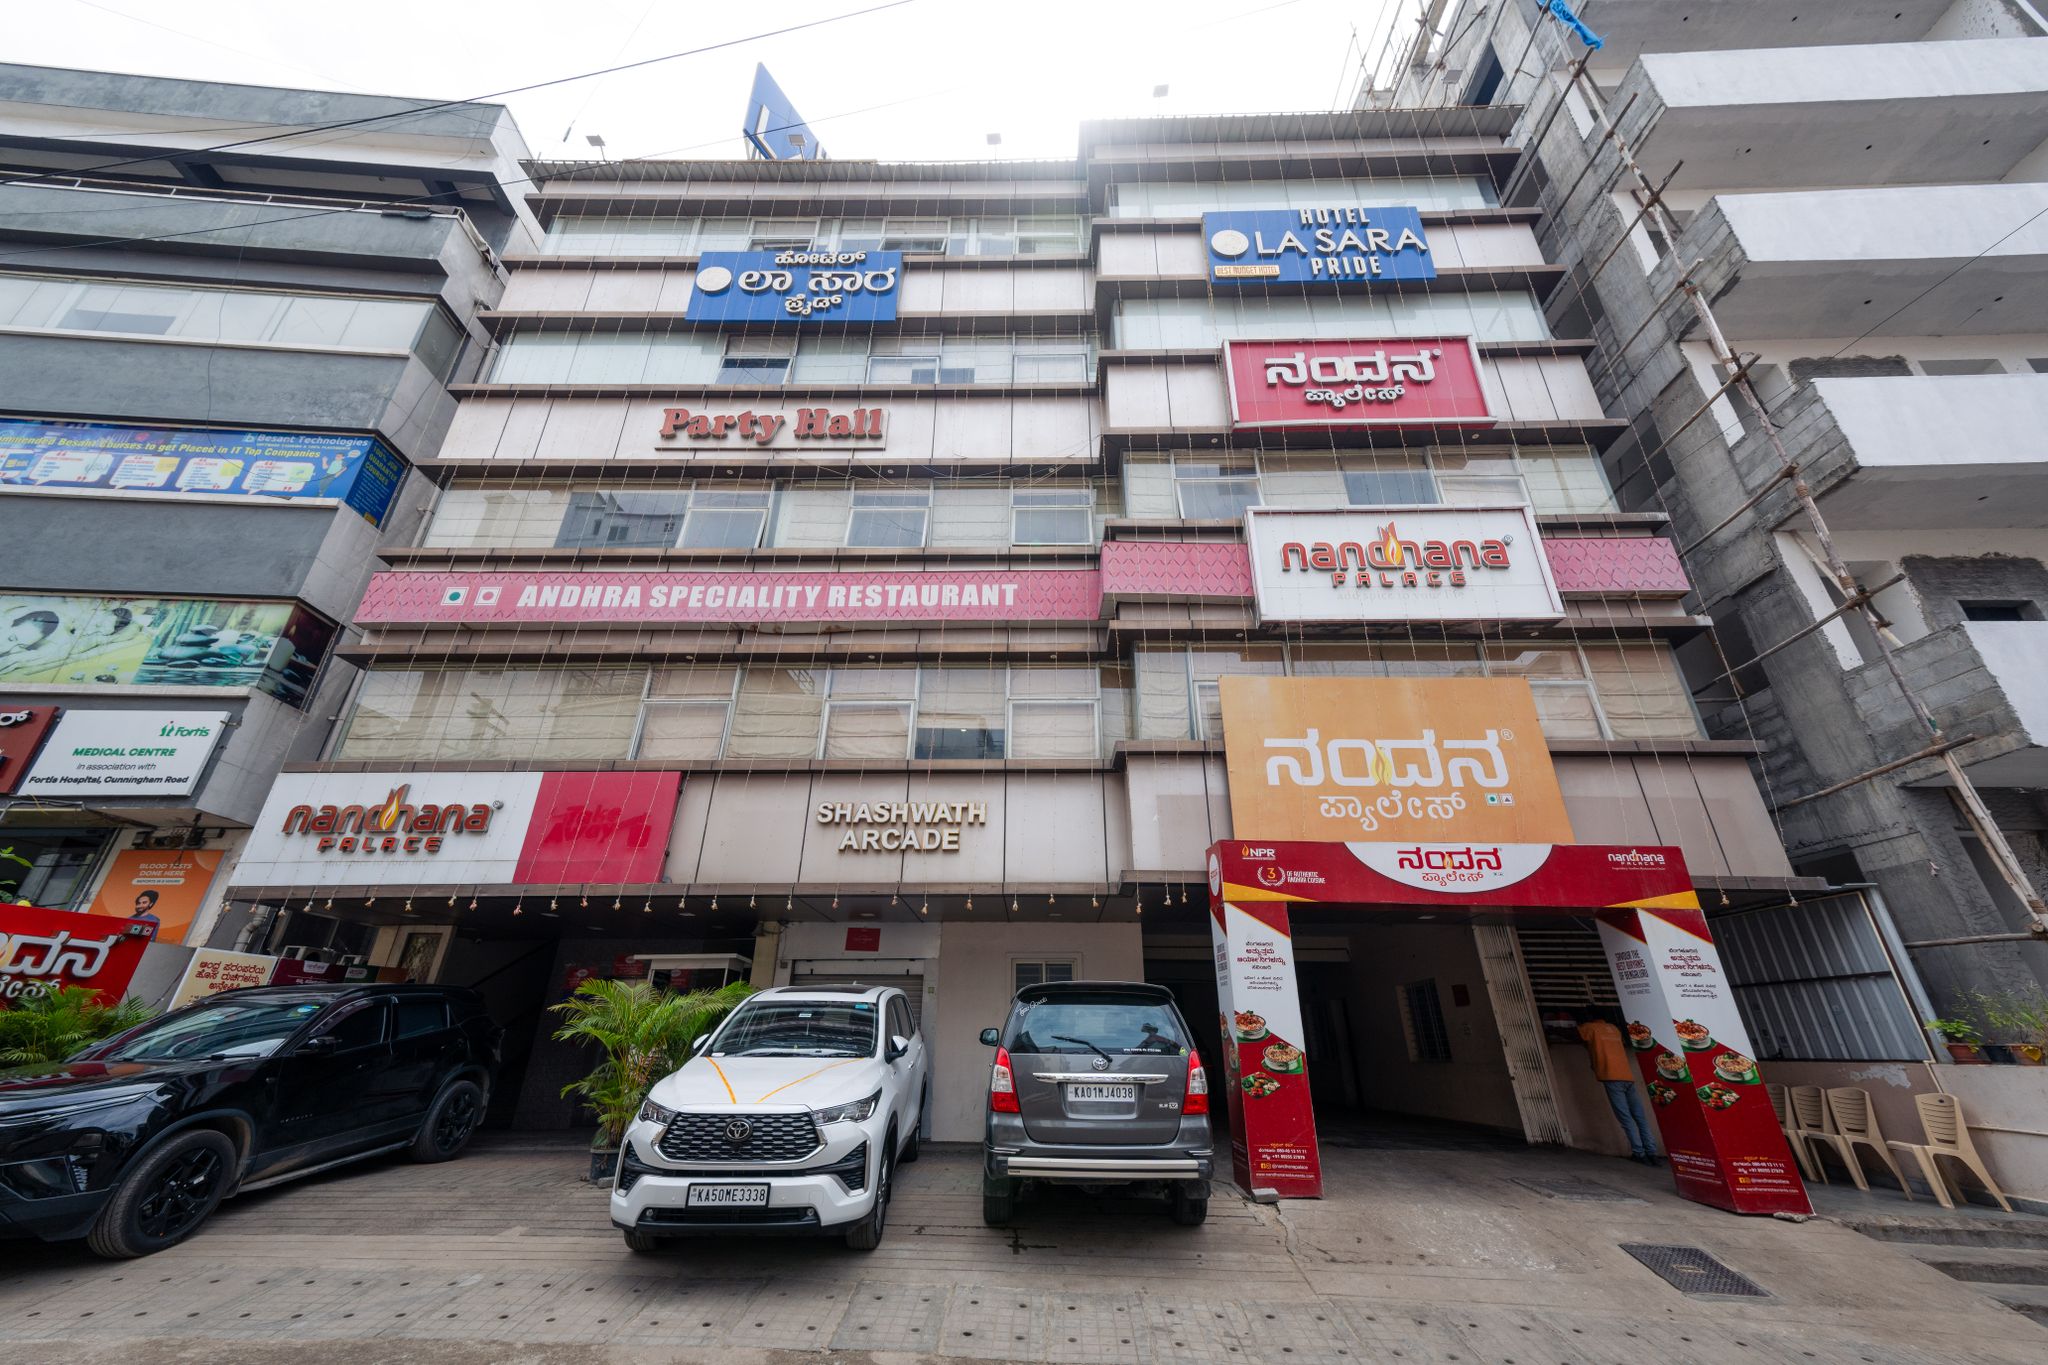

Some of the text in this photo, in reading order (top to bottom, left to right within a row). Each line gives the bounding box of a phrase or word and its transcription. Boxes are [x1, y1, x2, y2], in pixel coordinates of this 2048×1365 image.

[1299, 207, 1371, 226] HOTEL
[1255, 227, 1428, 256] LA SARA
[1311, 256, 1382, 277] PRIDE
[738, 270, 794, 292] ಲಾ
[1264, 349, 1438, 387] ನಂದನ
[1304, 385, 1406, 409] ಪ್ಯಾಲೇಸ್
[660, 408, 883, 446] Party Hall
[145, 442, 156, 451] to
[158, 444, 176, 454] get
[179, 444, 217, 454] Placed
[217, 446, 228, 454] in
[231, 446, 242, 454] IT
[243, 447, 261, 457] Top
[261, 448, 321, 458] Companies
[257, 434, 295, 444] Besant
[298, 434, 369, 448] Technologies
[1281, 521, 1510, 572] nandhana
[1331, 570, 1466, 588] PALACE
[517, 584, 1018, 608] ANDHRA SPECIALITY RESTAURANT
[175, 726, 210, 737] Fortis
[72, 747, 176, 757] MEDICAL CENTRE
[1263, 727, 1510, 788] ನಂದನ
[86, 763, 136, 771] association
[28, 776, 189, 786] Fortis Hospital, Cunningham Road
[281, 783, 494, 834] nandhana
[817, 801, 987, 825] SHASHWATH
[1318, 789, 1466, 832] ಪ್ಯಾಲೇಸ್
[316, 836, 443, 853] PALACE
[838, 828, 960, 852] ARCADE
[1250, 847, 1276, 857] NPR
[1397, 846, 1502, 870] ನಂದನ
[1608, 848, 1665, 862] nandhana
[1422, 870, 1484, 887] ಪ್ಯಾಲೇಸ್
[0, 931, 118, 978] ದನ
[1074, 1086, 1133, 1099] KA01MJ4038
[696, 1188, 766, 1203] KA50ME3338
